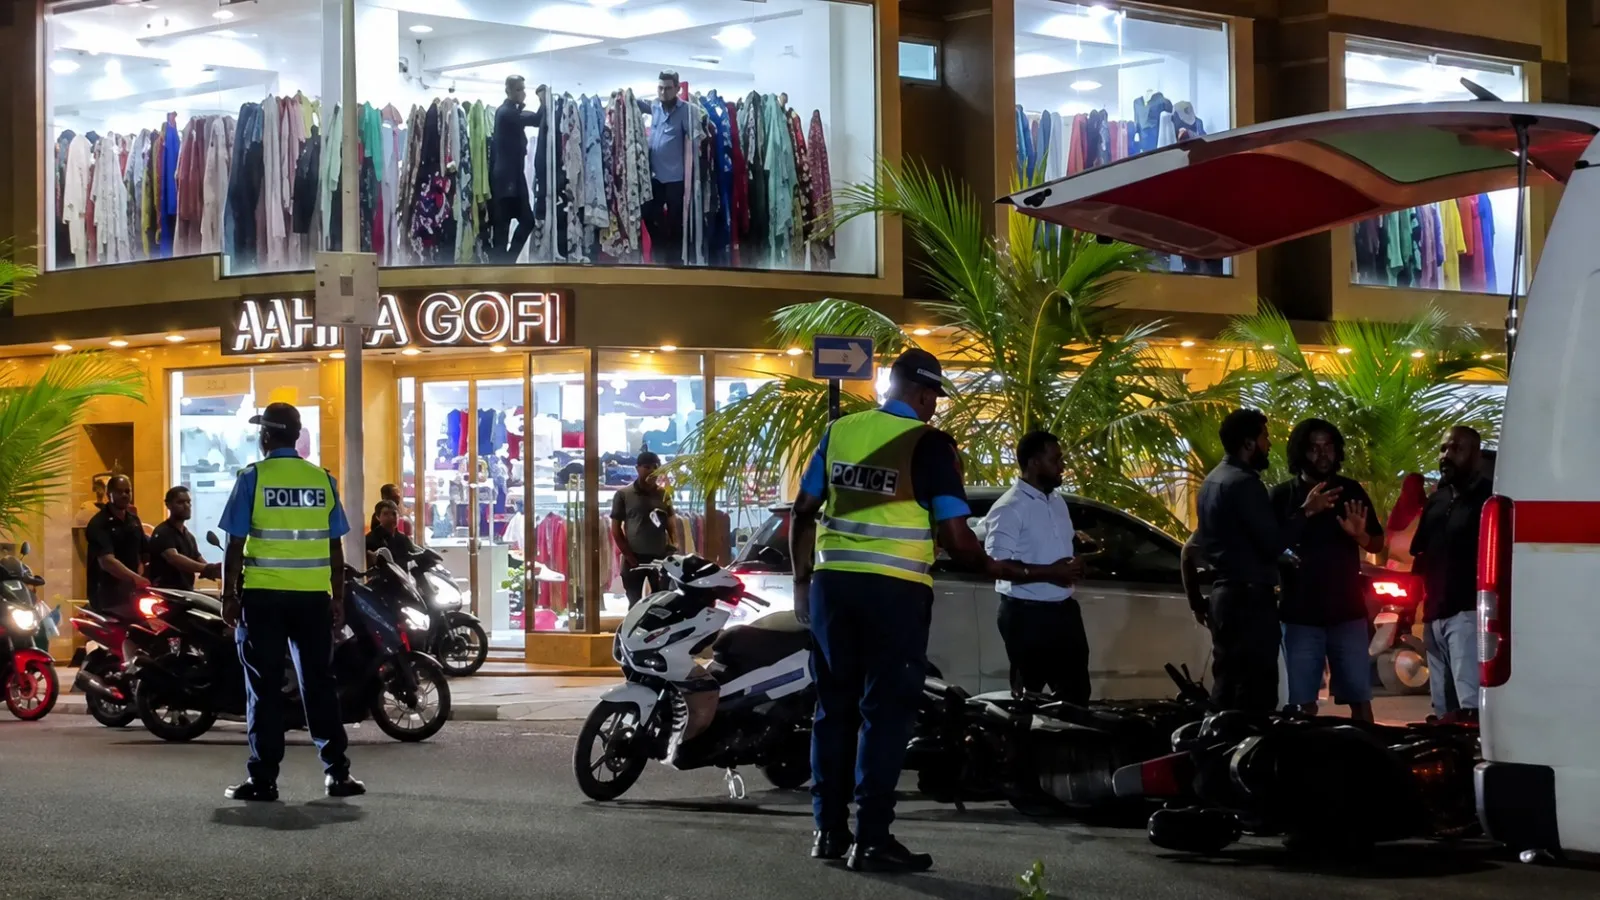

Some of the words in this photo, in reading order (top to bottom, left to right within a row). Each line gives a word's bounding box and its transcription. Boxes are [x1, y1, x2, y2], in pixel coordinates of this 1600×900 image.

[417, 291, 561, 344] GOFI
[831, 464, 897, 492] POLICE
[265, 489, 325, 507] POLICE
